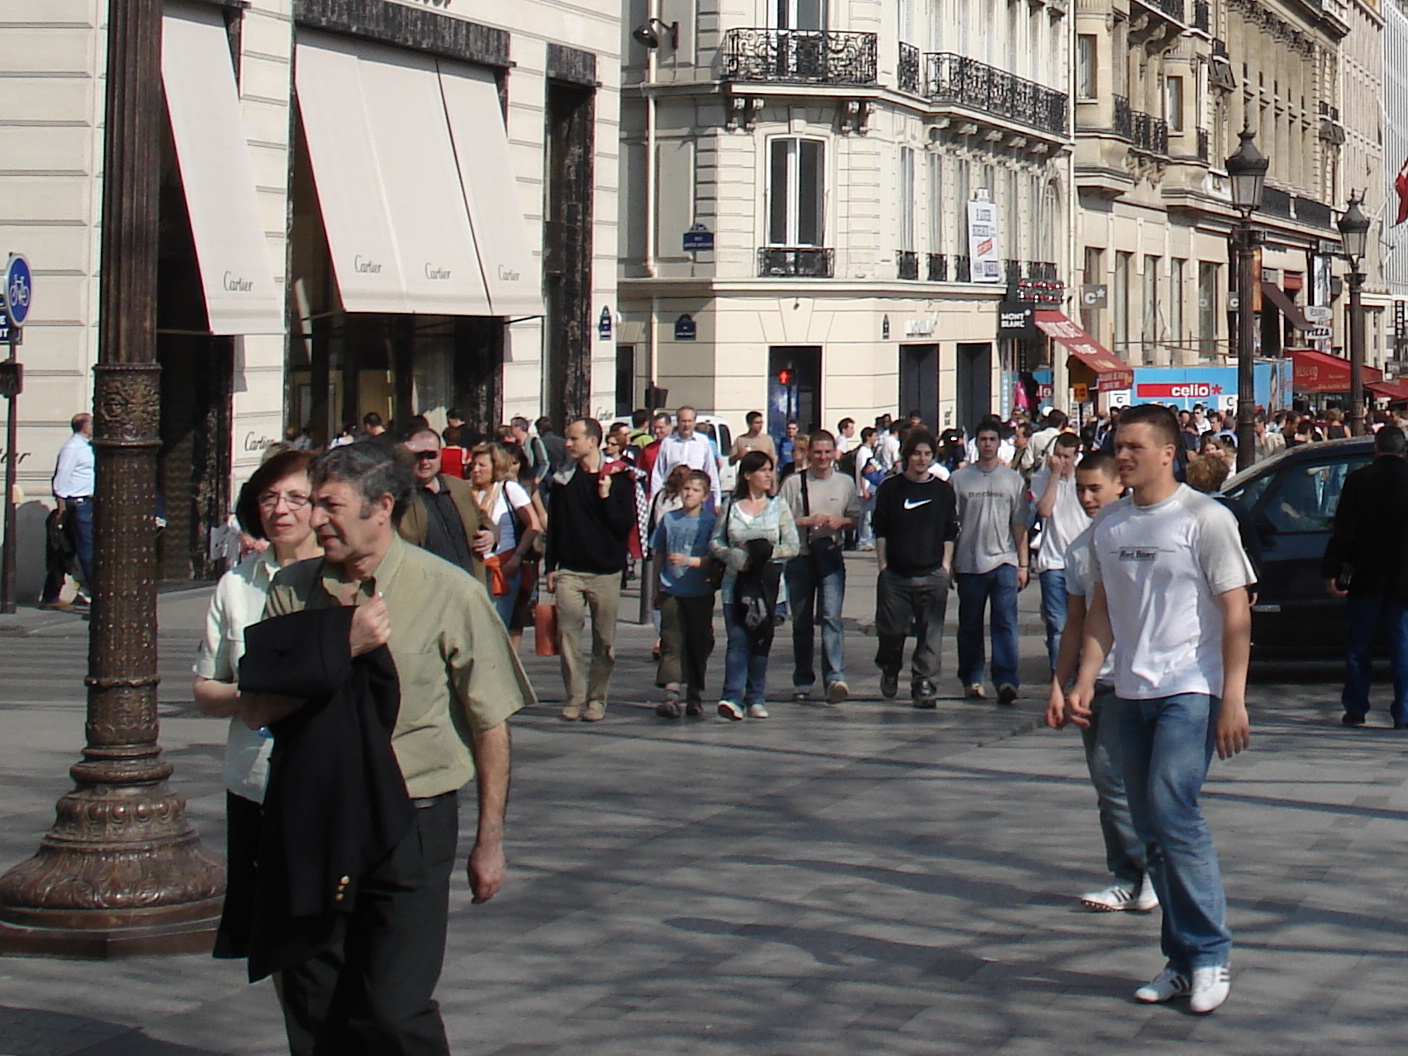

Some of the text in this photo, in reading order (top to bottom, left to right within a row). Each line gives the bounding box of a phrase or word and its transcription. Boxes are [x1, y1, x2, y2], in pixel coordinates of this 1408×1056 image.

[355, 254, 383, 274] Cartier
[425, 262, 451, 280] Cartier
[498, 264, 520, 281] Cartier
[223, 271, 253, 292] Cartier
[1001, 320, 1025, 328] BLANC
[1307, 328, 1330, 337] PIZZA
